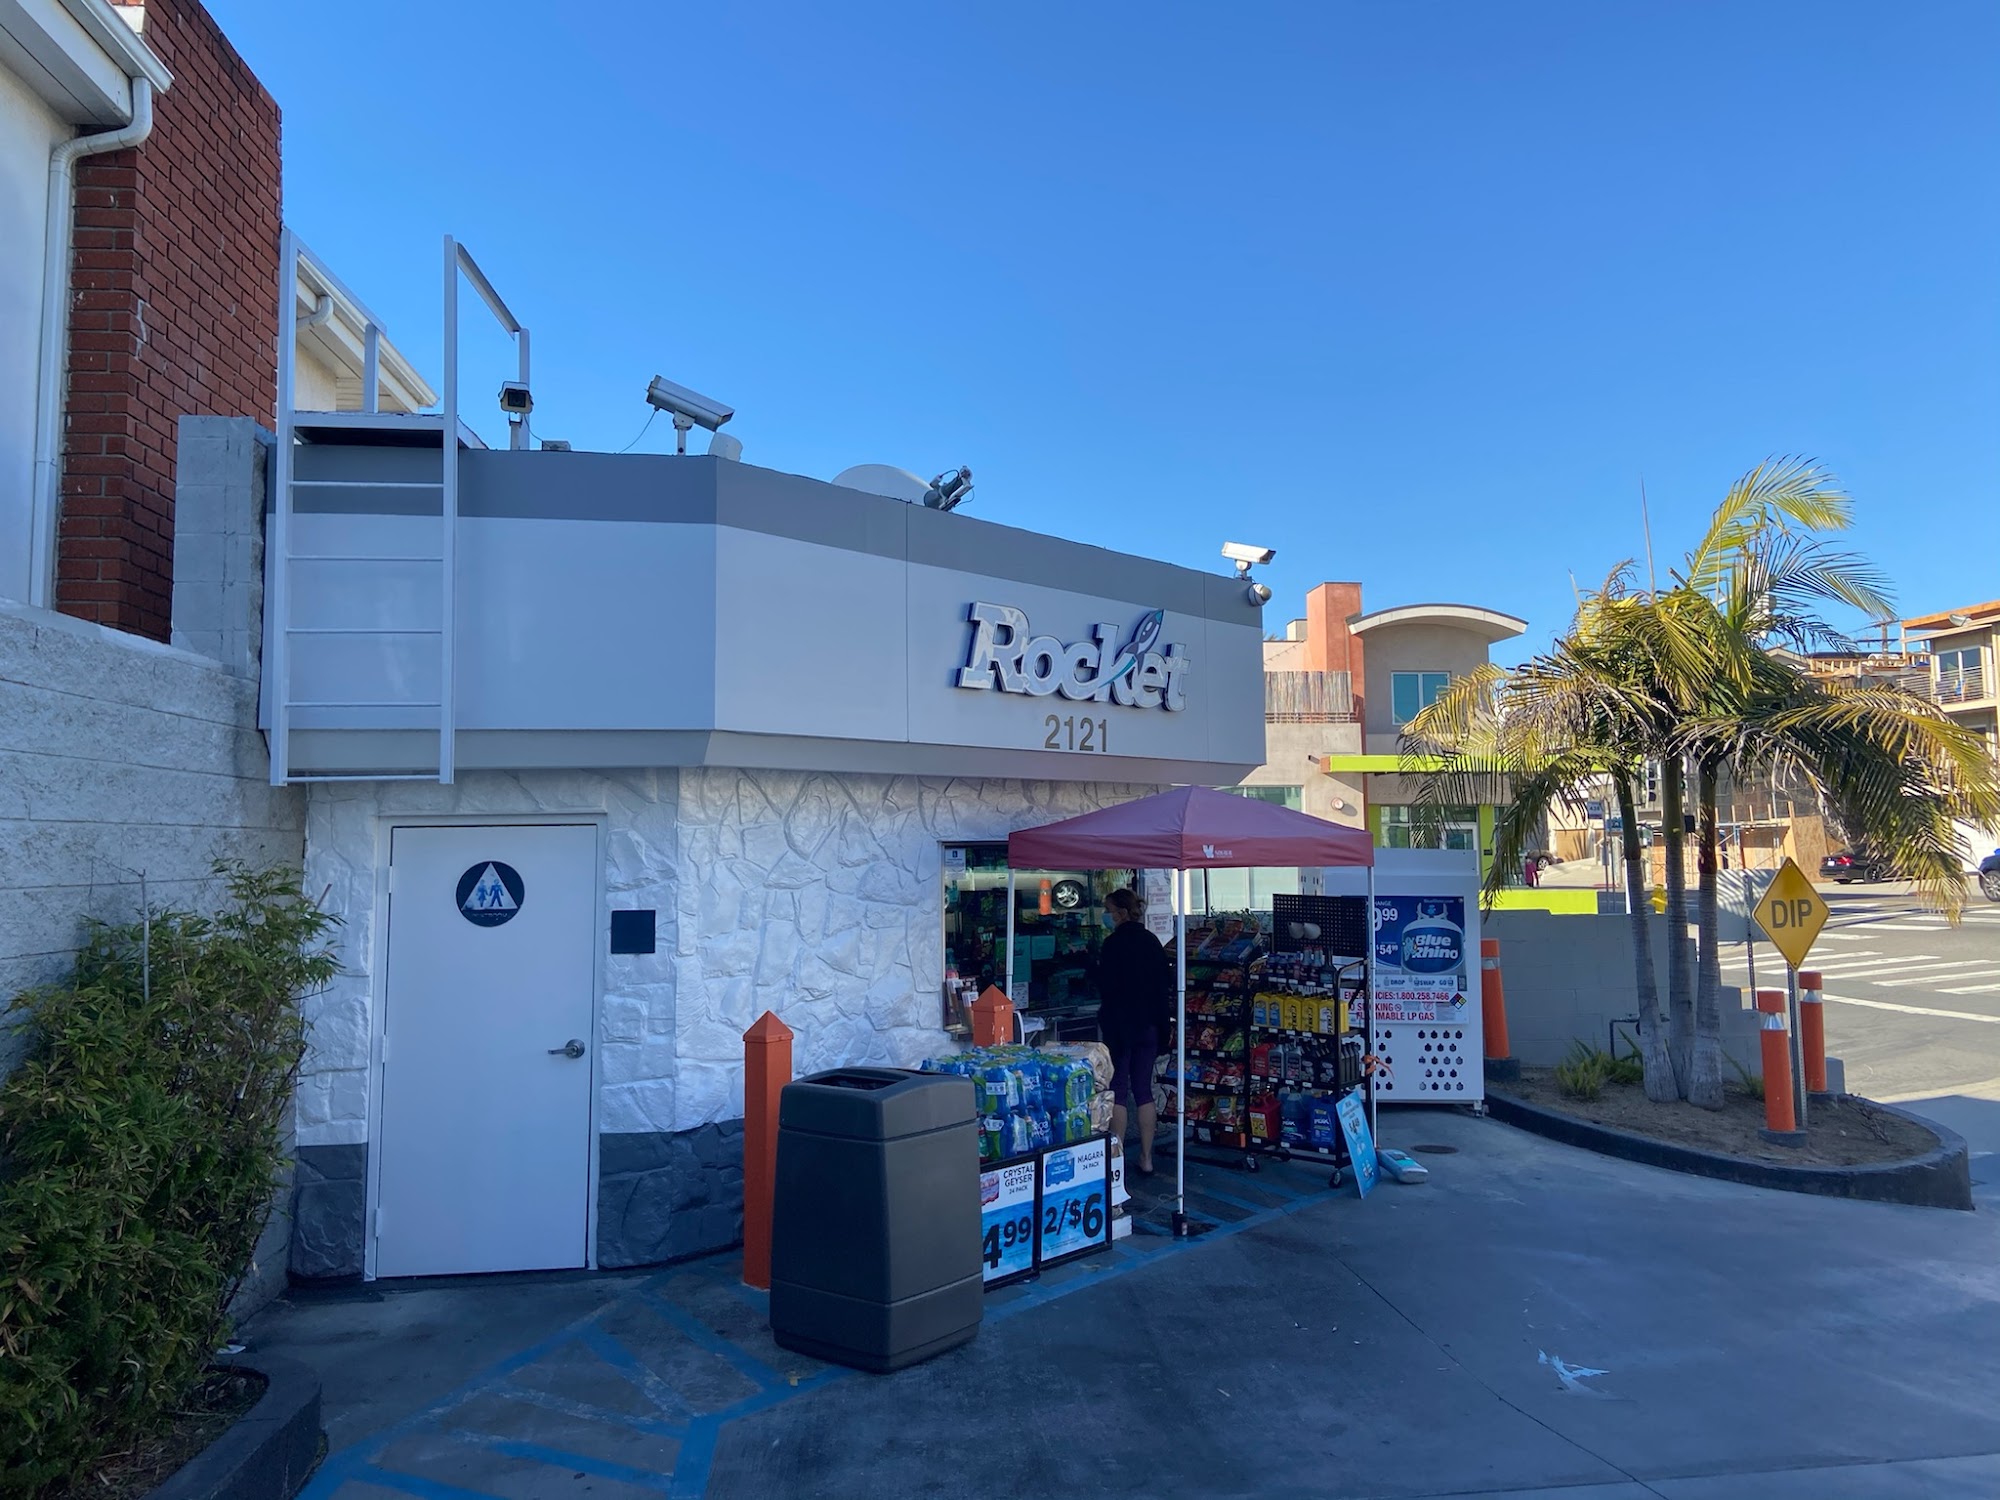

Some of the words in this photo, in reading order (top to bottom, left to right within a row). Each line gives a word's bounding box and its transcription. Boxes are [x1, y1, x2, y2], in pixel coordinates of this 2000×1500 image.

[956, 601, 1190, 711] Rocket
[1044, 715, 1108, 752] 2121
[1771, 899, 1812, 928] DIP
[1415, 934, 1451, 946] Blue
[1412, 946, 1458, 959] Rhino
[1407, 1012, 1416, 1020] LP
[1419, 1012, 1435, 1020] GAS
[1077, 1150, 1104, 1163] NIAGARA
[1088, 1161, 1099, 1169] PACK
[1003, 1165, 1035, 1179] CRYSTAL
[1004, 1174, 1033, 1187] GEYSER
[1015, 1185, 1028, 1193] PACK
